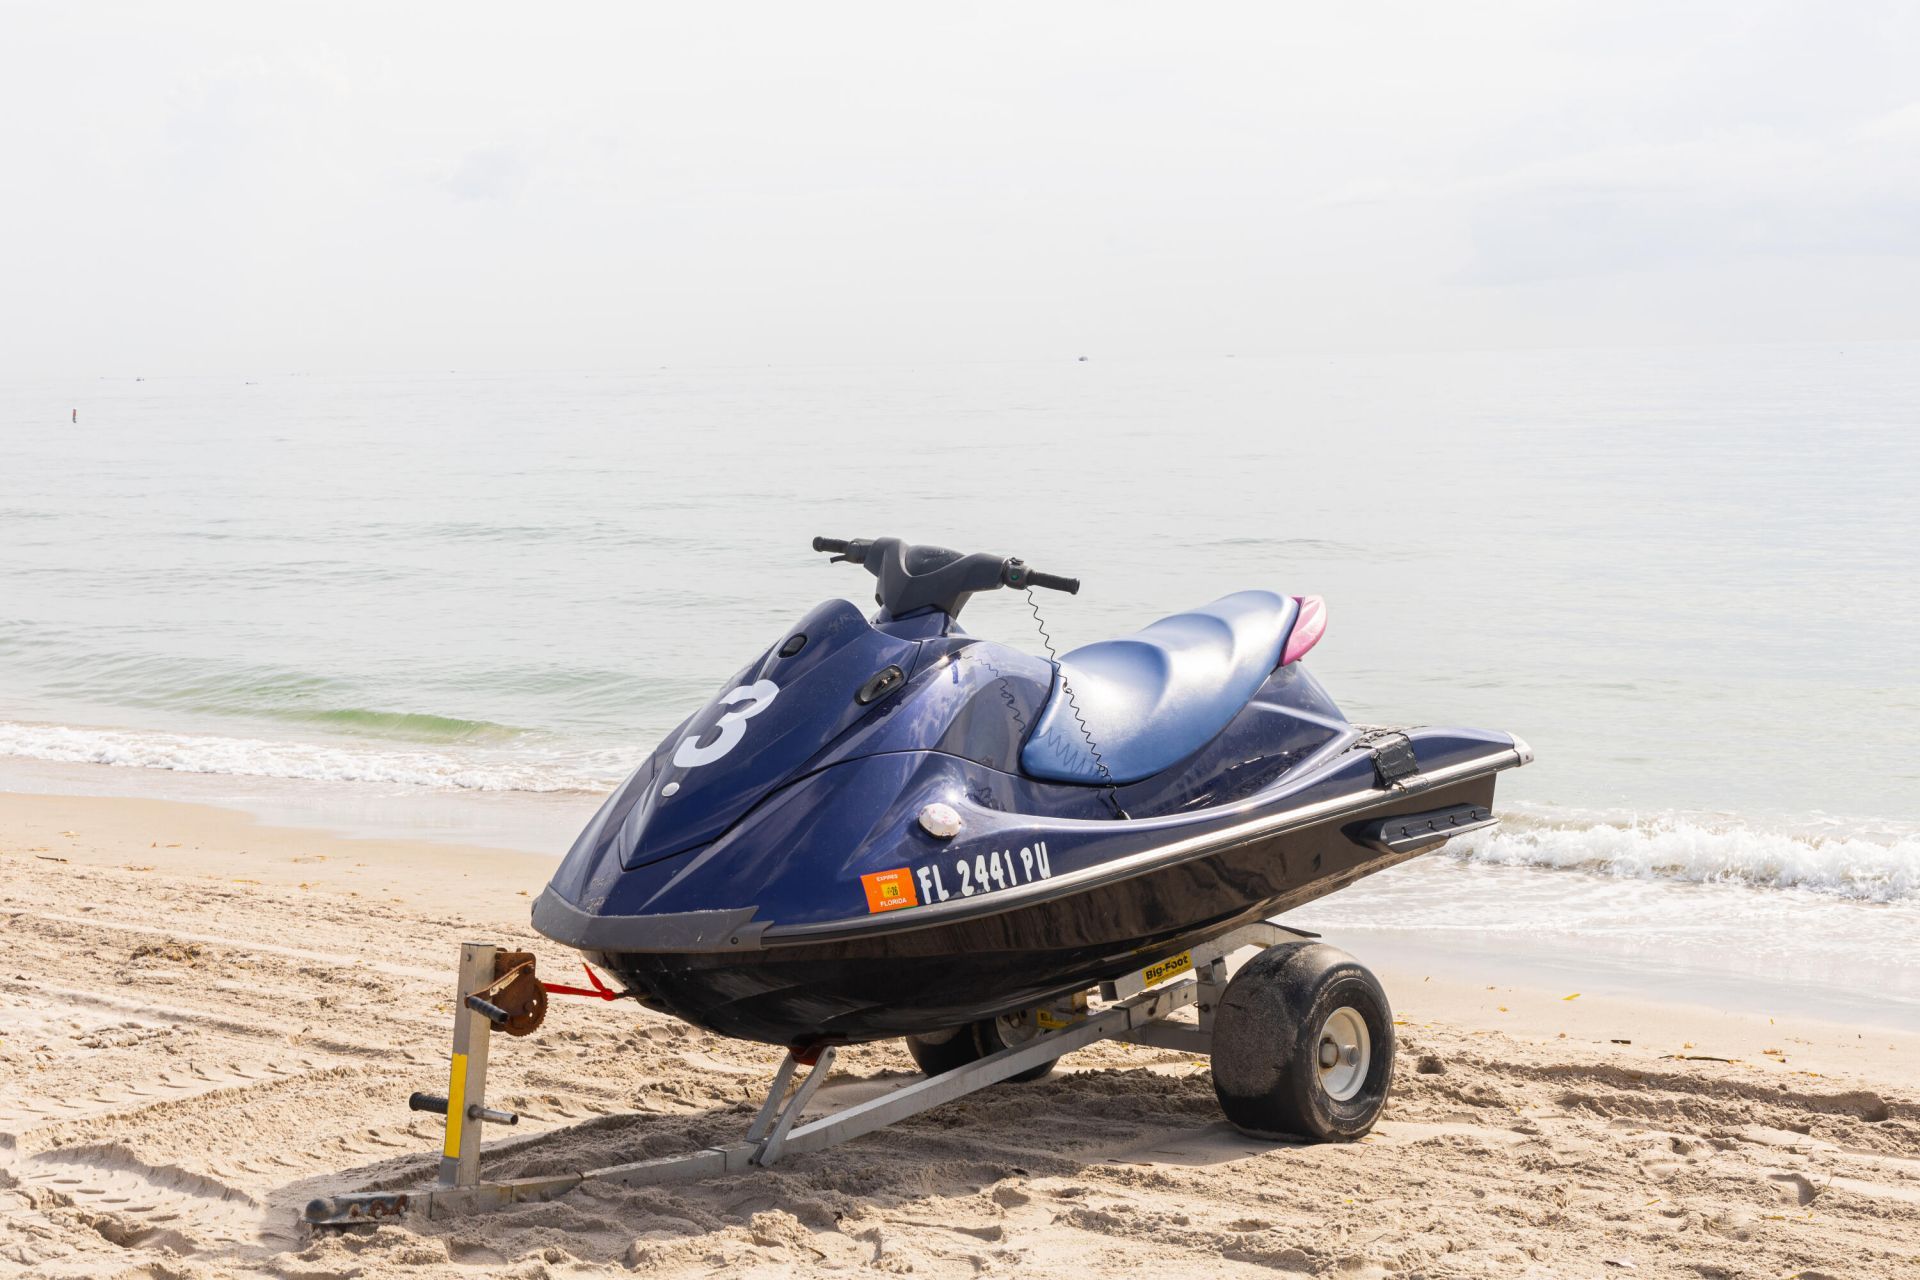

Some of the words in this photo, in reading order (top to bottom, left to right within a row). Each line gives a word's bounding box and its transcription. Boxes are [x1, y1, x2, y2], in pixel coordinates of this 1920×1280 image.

[673, 679, 780, 768] 3
[876, 874, 899, 882] EXPIRES
[916, 864, 950, 905] FL
[956, 850, 1018, 897] 2441
[1020, 841, 1051, 882] PU
[880, 897, 908, 907] FLORIDA
[1145, 955, 1189, 981] Big-Foot
